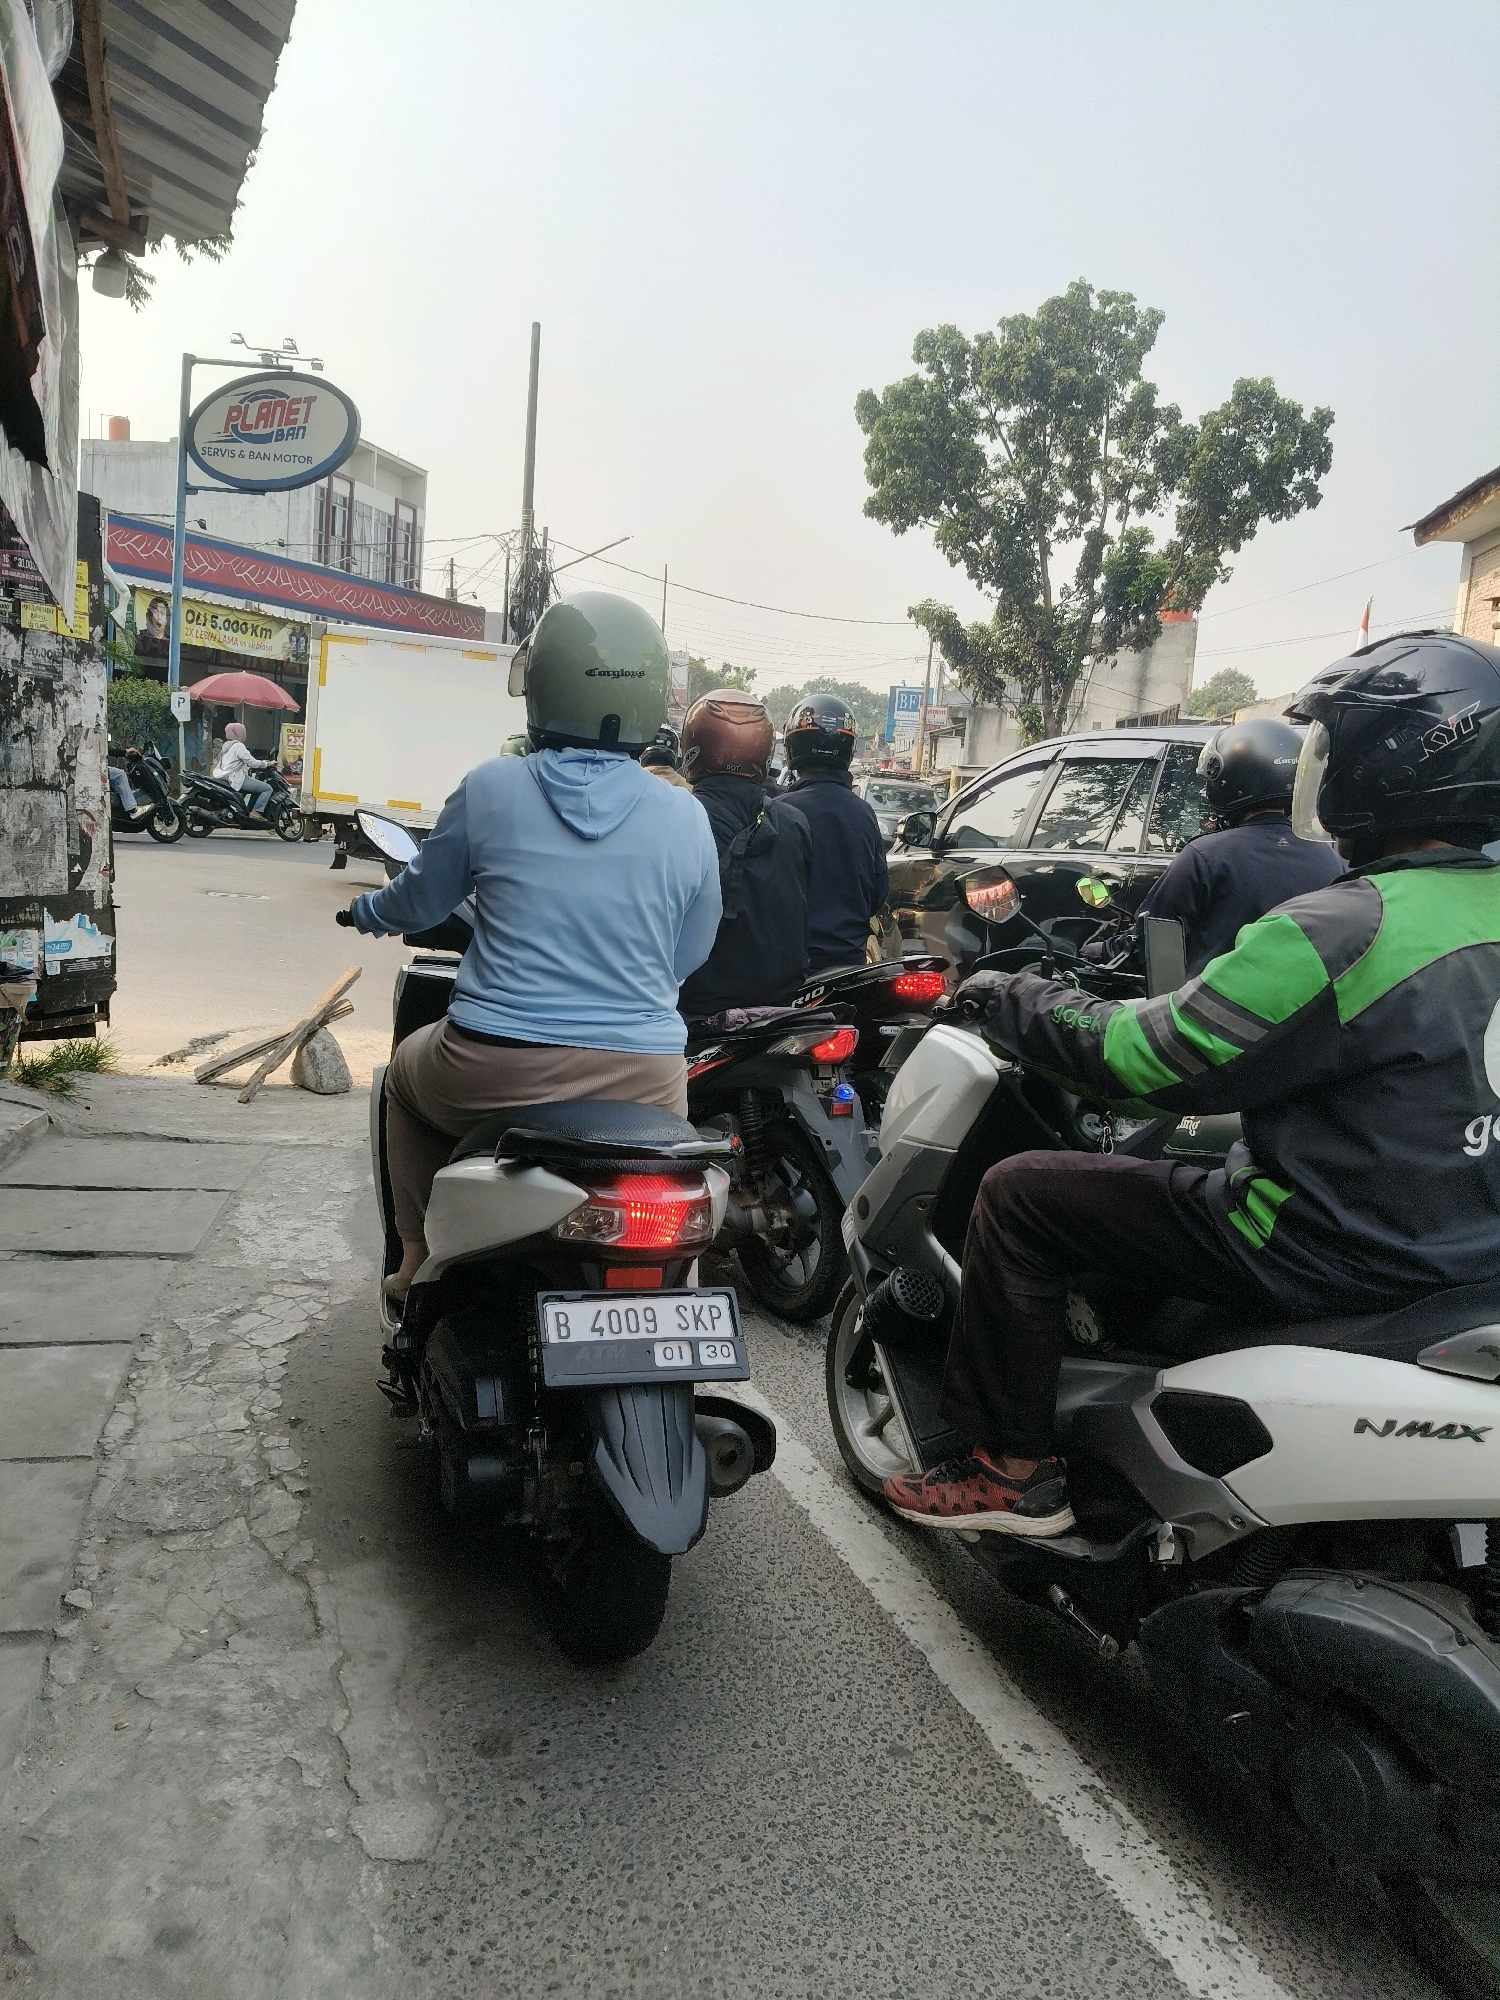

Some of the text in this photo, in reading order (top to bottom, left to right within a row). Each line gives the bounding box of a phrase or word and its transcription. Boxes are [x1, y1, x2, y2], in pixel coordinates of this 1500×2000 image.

[223, 396, 317, 434] PLANET
[274, 426, 307, 442] BAN
[201, 446, 313, 465] SERVIS & BAN MOTOR
[185, 609, 273, 640] OLI 5.000 Km
[184, 627, 194, 638] 2X
[195, 629, 217, 642] LEBIH
[217, 634, 239, 647] LAMA
[178, 697, 186, 708] P
[288, 736, 304, 747] 2X
[1273, 756, 1299, 766] Cargl
[790, 985, 826, 1008] RIO
[555, 1304, 722, 1340] B 4009 SKP
[662, 1344, 731, 1361] 01 30
[1354, 1417, 1493, 1442] NMAX
